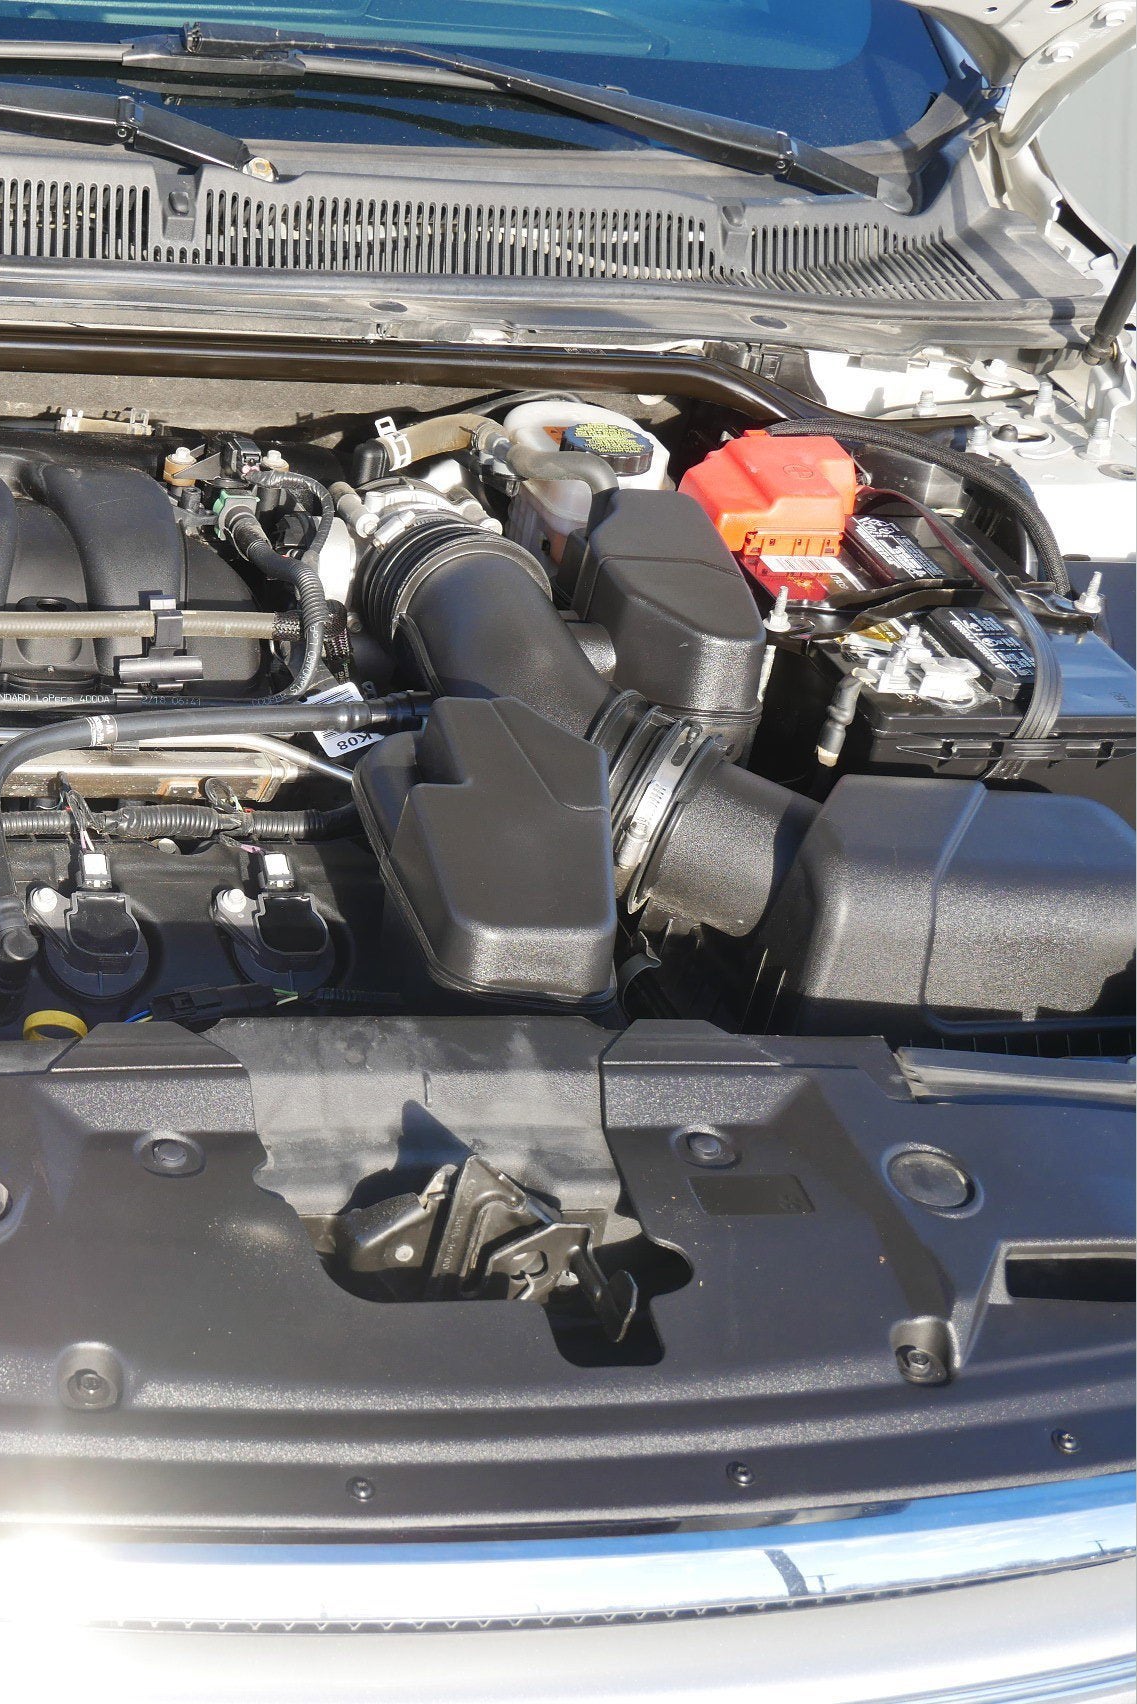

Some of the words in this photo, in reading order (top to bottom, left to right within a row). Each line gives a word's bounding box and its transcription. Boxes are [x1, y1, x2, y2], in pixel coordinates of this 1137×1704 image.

[36, 694, 74, 703] LoPerm
[79, 695, 111, 703] 4000A
[289, 650, 317, 696] STANDARD
[337, 733, 373, 751] K08
